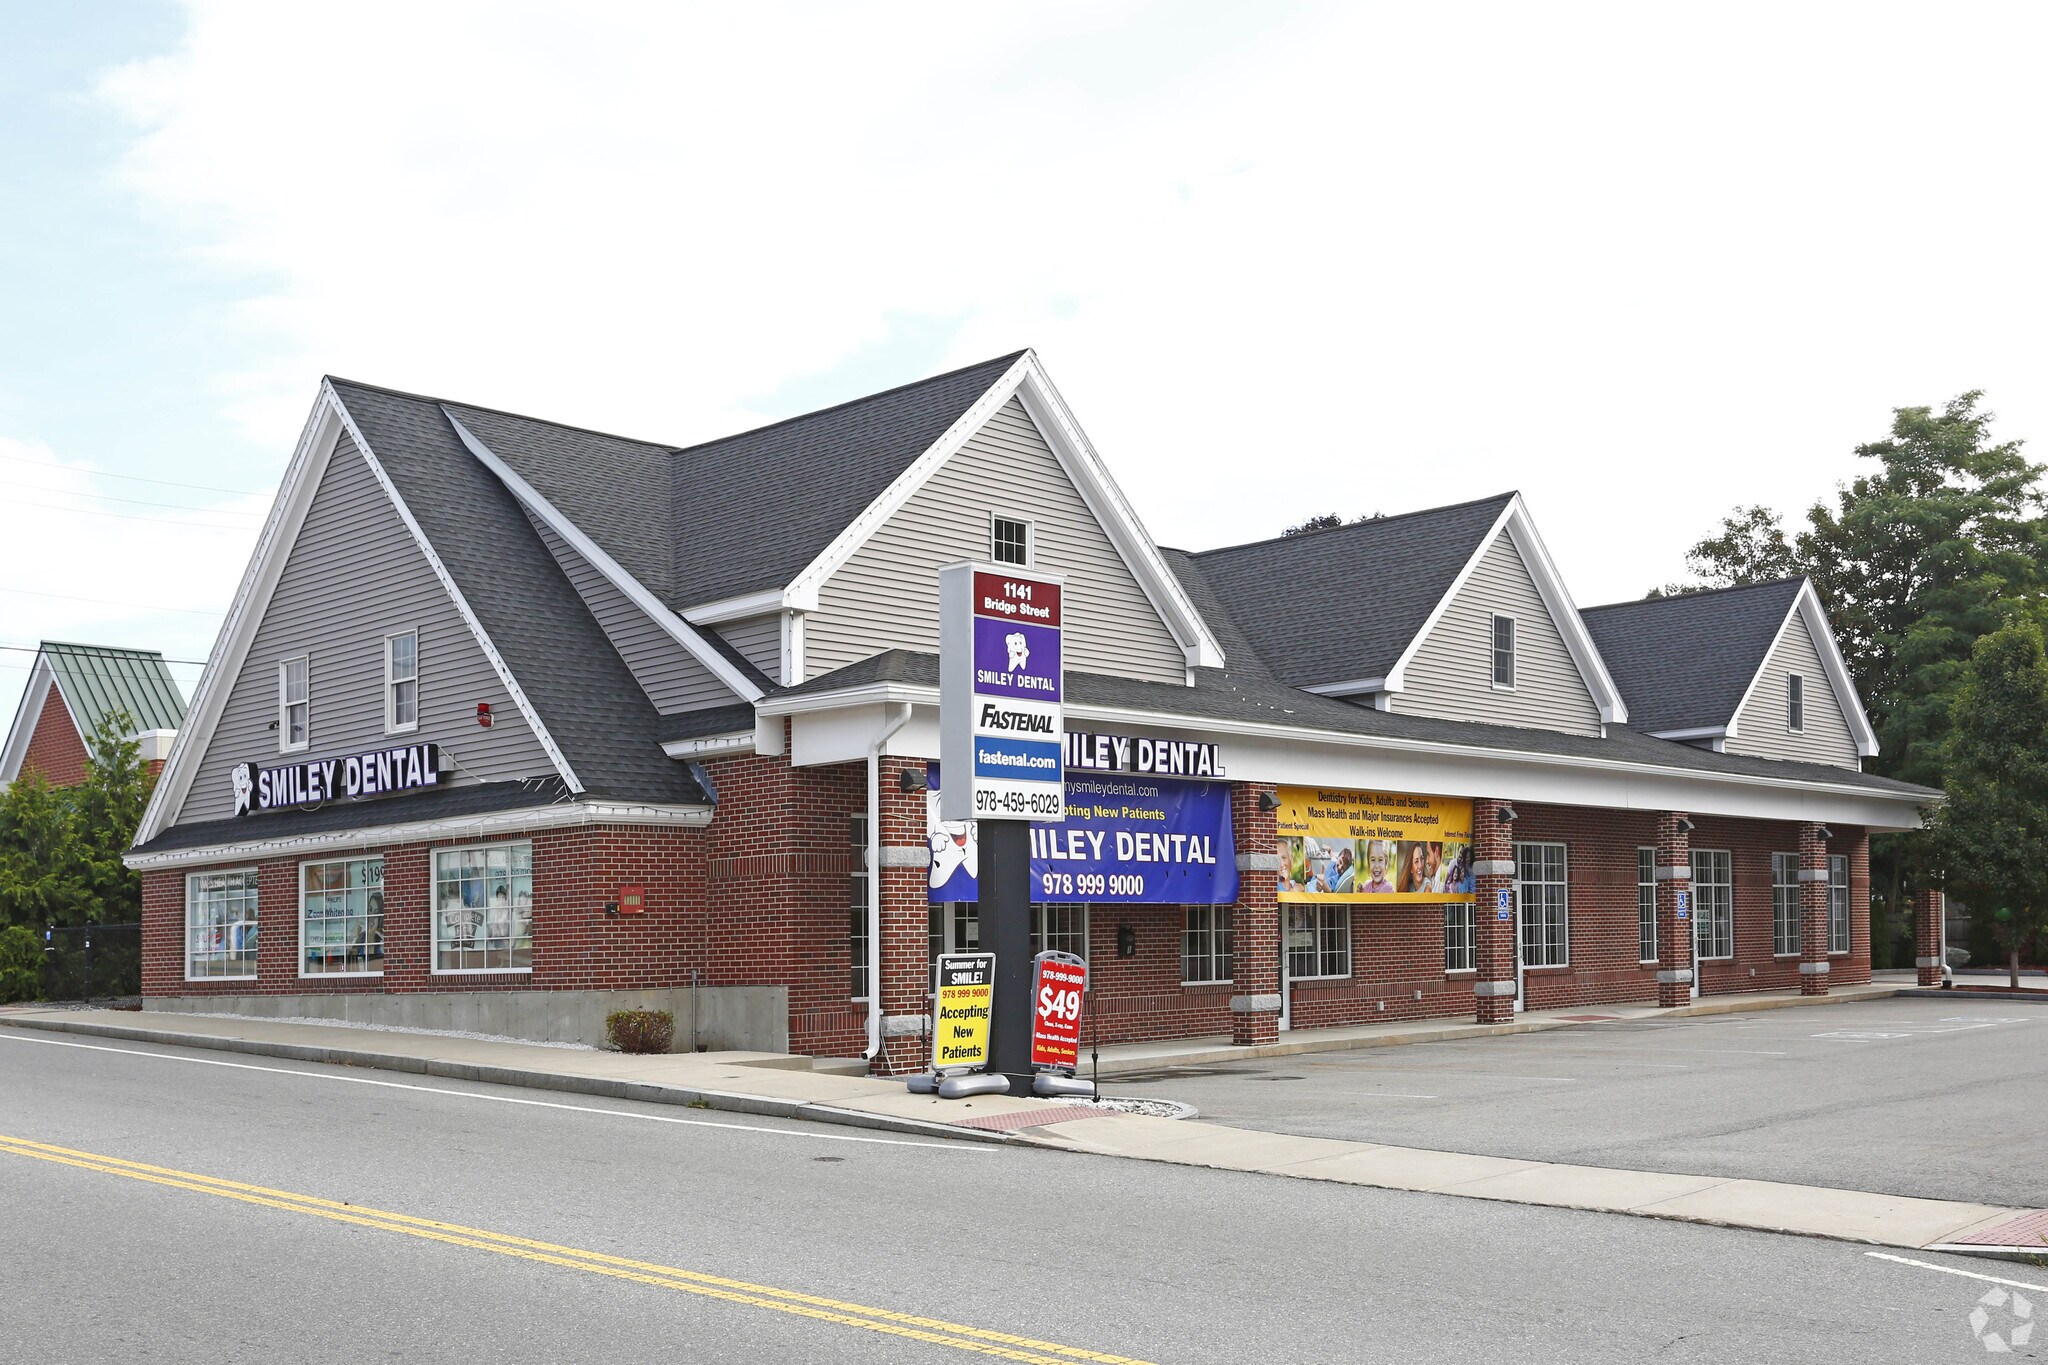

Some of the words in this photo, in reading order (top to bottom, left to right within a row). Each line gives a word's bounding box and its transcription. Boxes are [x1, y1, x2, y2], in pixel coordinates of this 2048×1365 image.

[1003, 581, 1032, 601] 1141
[984, 596, 1017, 615] Bridge
[1019, 602, 1050, 618] Street
[977, 669, 1014, 686] SMILEY
[1017, 674, 1056, 691] DENTAL
[979, 749, 1056, 769] fastenal.com
[1138, 738, 1226, 777] DENTAL
[259, 759, 338, 808] SMILEY
[346, 744, 438, 796] DENTAL
[976, 789, 1060, 815] 978-459-6029
[1317, 791, 1347, 805] Dentistry
[1348, 793, 1357, 804] for
[1359, 793, 1375, 807] Kids,
[1376, 795, 1394, 807] Adults
[1396, 797, 1406, 807] and
[1408, 797, 1430, 809] Seniors
[1094, 805, 1119, 818] New
[1121, 806, 1166, 820] Patients
[1308, 806, 1325, 818] Mass
[1326, 808, 1347, 819] Health
[1348, 809, 1360, 820] and
[1362, 810, 1379, 822] Major
[1381, 811, 1412, 823] Insurances
[1413, 813, 1438, 826] Accepted
[1349, 825, 1376, 837] Walk-ins
[1377, 827, 1403, 839] Welcome
[1116, 832, 1216, 864] DENTAL
[1042, 873, 1073, 895] 978
[1076, 873, 1105, 895] 999
[1109, 874, 1144, 895] 9000
[945, 959, 975, 970] Summer
[976, 958, 988, 969] for
[951, 971, 983, 985] SMILE!
[1042, 969, 1084, 985] 978-999-9000
[942, 989, 956, 999] 978
[957, 989, 970, 998] 999
[972, 988, 989, 998] 9000
[939, 1004, 990, 1020] Accepting
[953, 1025, 974, 1039] New
[1060, 1035, 1078, 1044] Accepted
[942, 1044, 982, 1059] Patients
